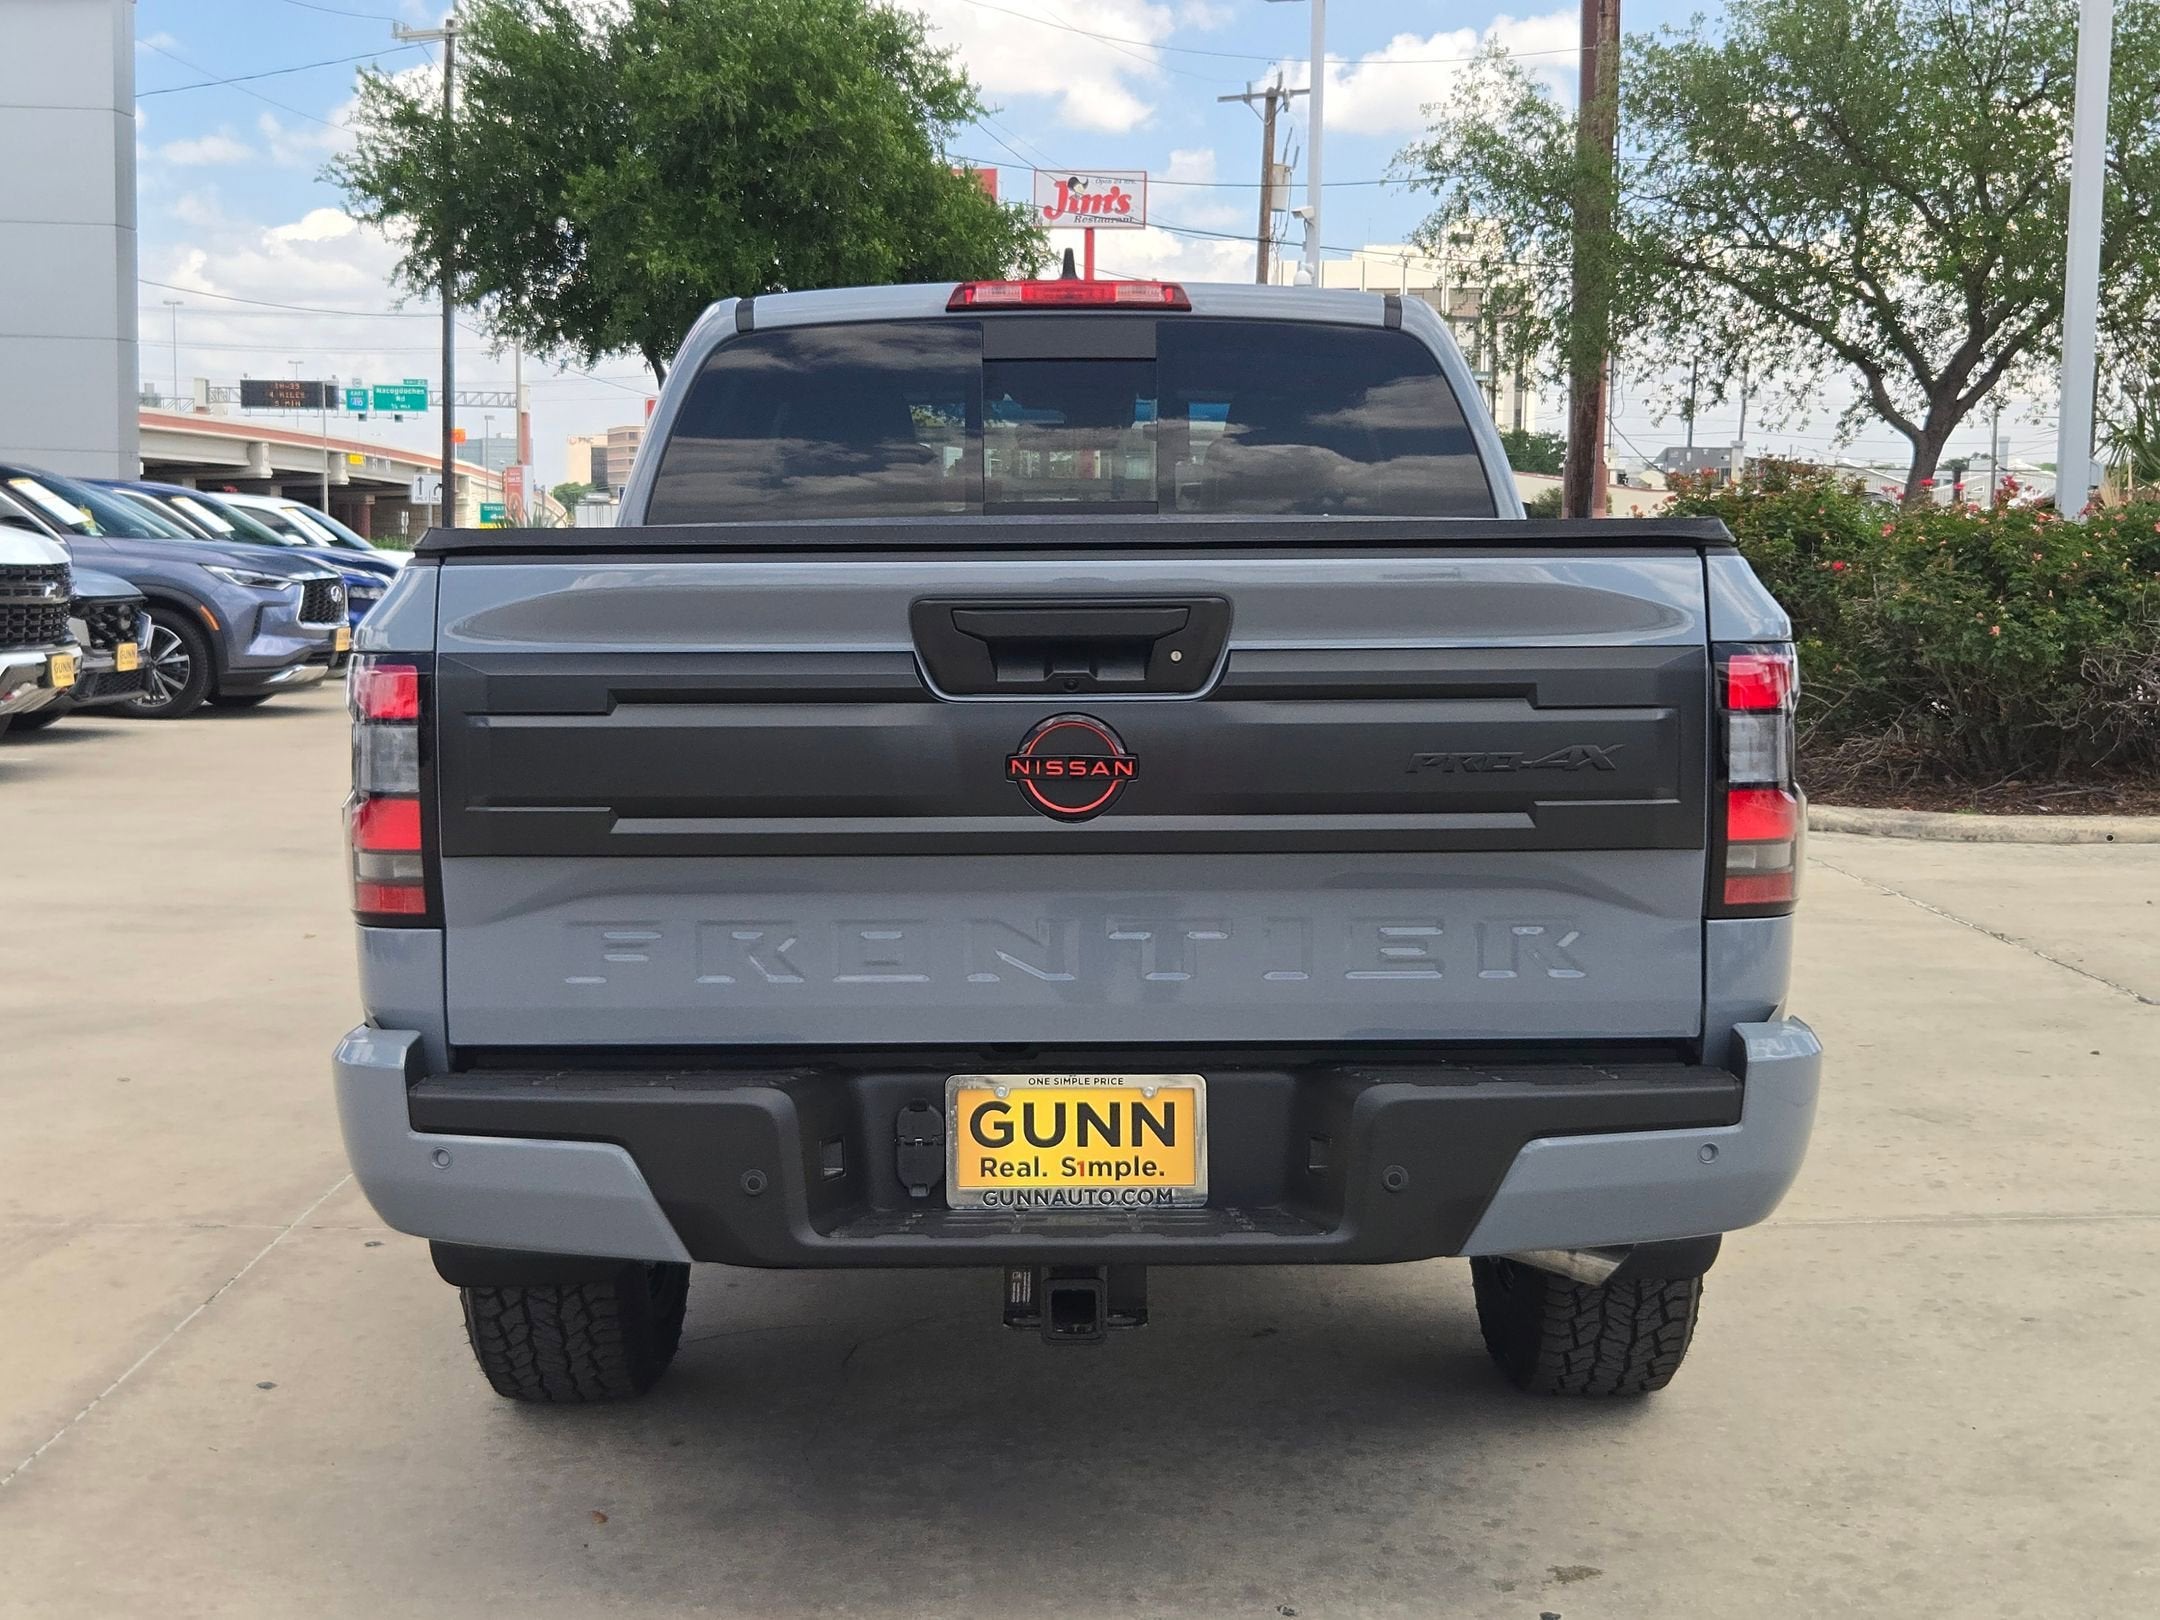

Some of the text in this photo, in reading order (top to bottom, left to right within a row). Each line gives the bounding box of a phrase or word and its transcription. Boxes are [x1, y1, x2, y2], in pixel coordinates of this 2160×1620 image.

[1043, 180, 1132, 220] Jim's
[54, 661, 72, 673] GUNN
[1011, 760, 1133, 776] NISSAN
[1405, 743, 1625, 773] PRO-4X
[564, 913, 1587, 983] FRONTIER
[1028, 1077, 1124, 1086] ONE SIMPLE PRICE
[969, 1100, 1176, 1148] GUNN
[980, 1156, 1048, 1177] Real.
[982, 1188, 1174, 1207] GUNNAUTO.COM
